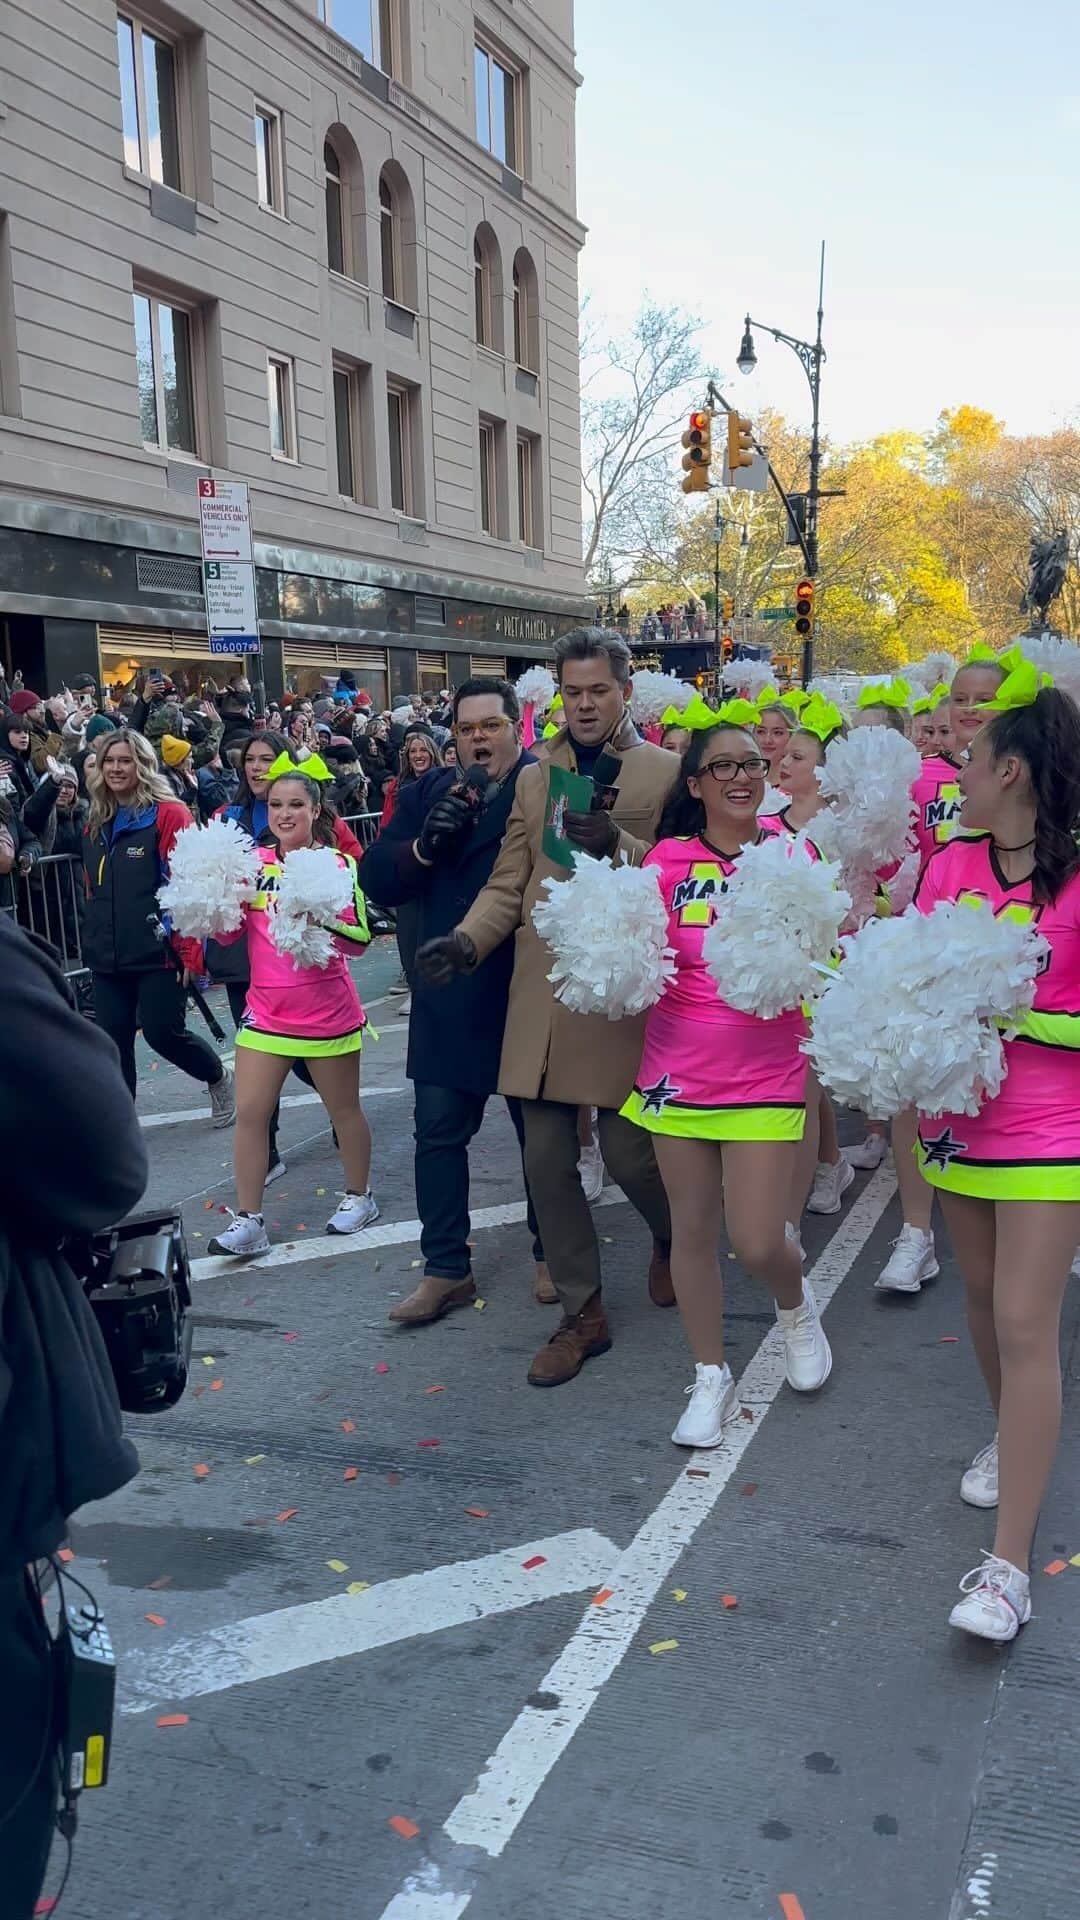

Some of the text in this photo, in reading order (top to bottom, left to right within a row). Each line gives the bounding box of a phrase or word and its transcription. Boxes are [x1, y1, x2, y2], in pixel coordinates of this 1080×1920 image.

[203, 481, 212, 497] 3
[202, 503, 242, 513] COMMERCIAL
[203, 512, 248, 522] VEHICLES ONLY
[209, 563, 218, 578] 5
[212, 642, 247, 652] 106007
